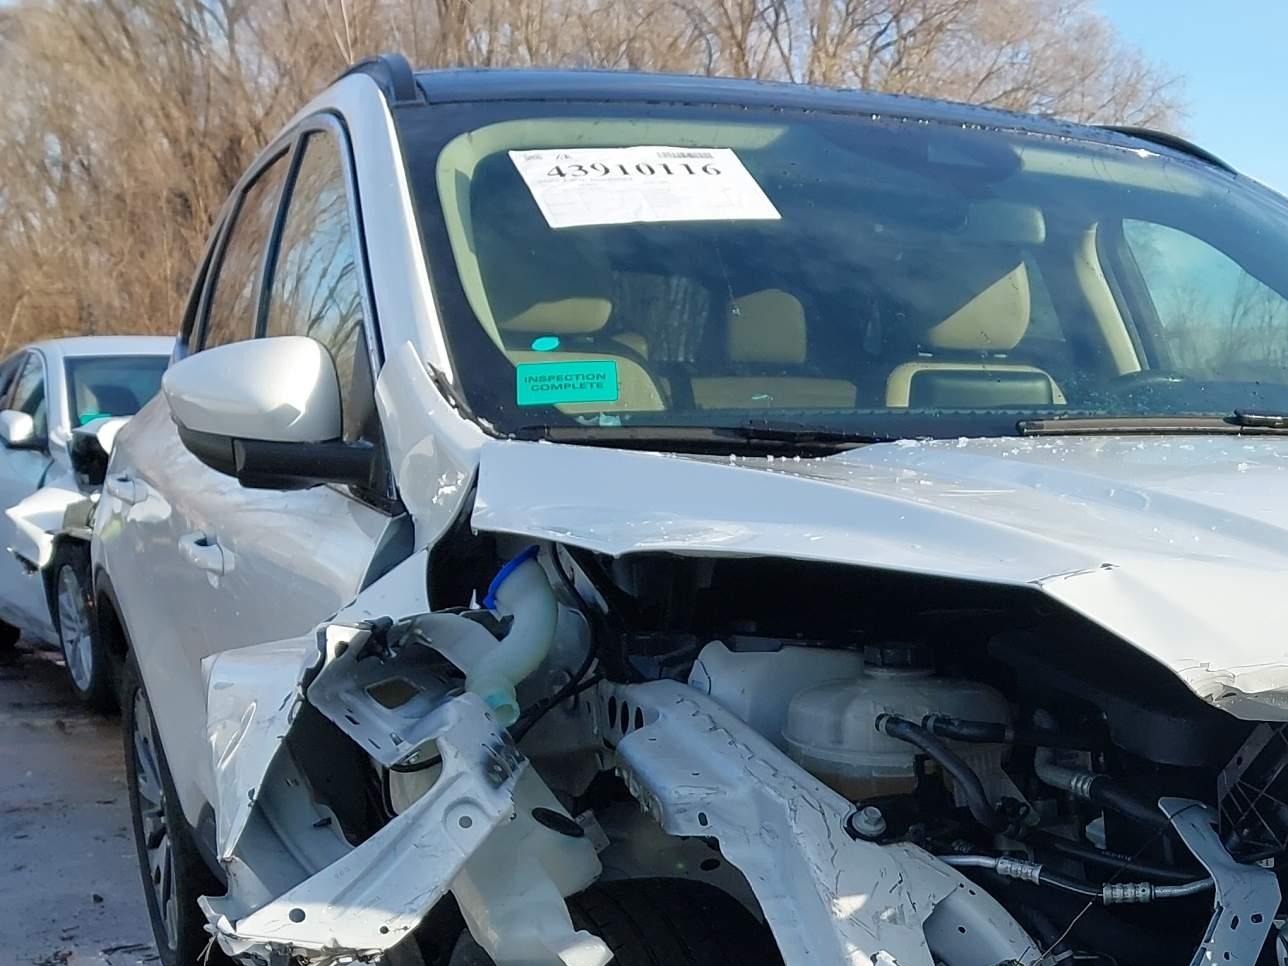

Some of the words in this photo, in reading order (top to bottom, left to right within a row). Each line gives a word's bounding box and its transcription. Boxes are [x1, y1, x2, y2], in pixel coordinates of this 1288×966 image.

[547, 162, 722, 178] 43910116
[524, 373, 606, 383] INSPECTION
[530, 381, 604, 392] COMPLETE
